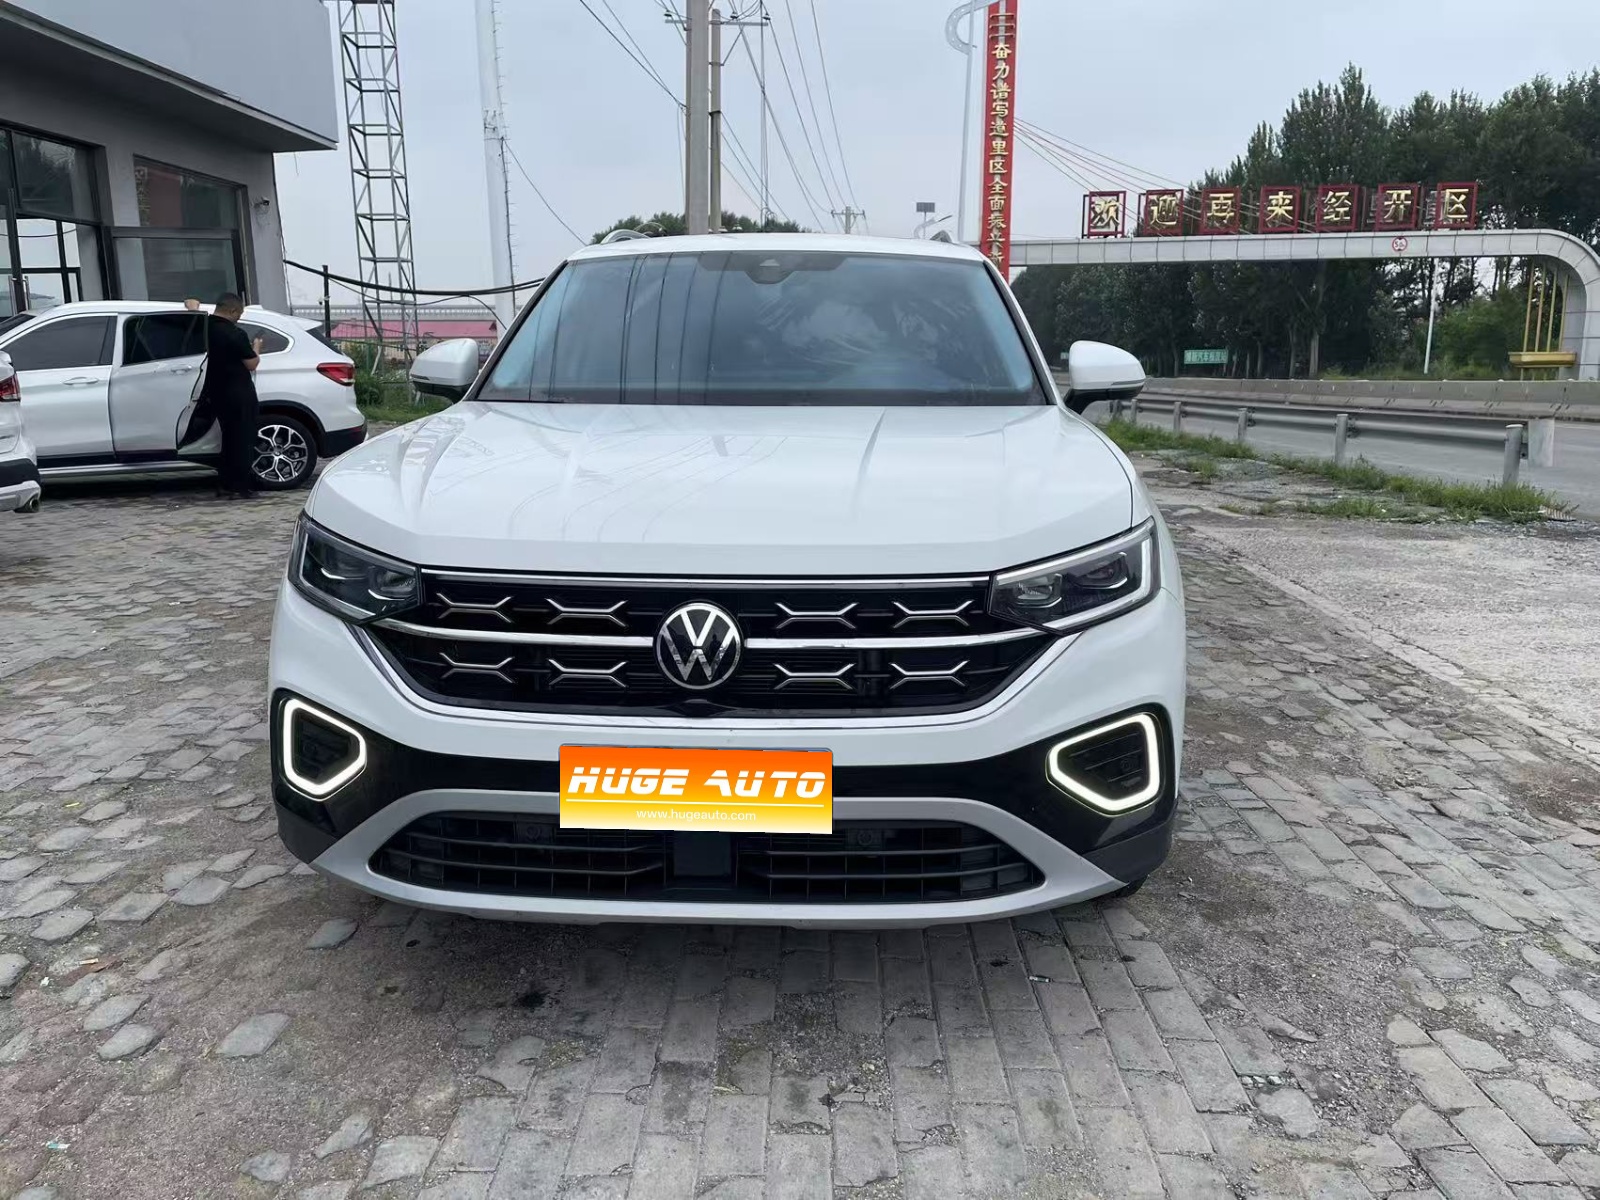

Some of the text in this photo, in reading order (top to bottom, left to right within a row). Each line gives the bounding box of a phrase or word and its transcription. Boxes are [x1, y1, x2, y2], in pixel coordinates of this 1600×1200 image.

[986, 43, 1012, 276] 奋力谱写道里区全面振兴新
[1090, 188, 1469, 228] 欢迎再来经开区
